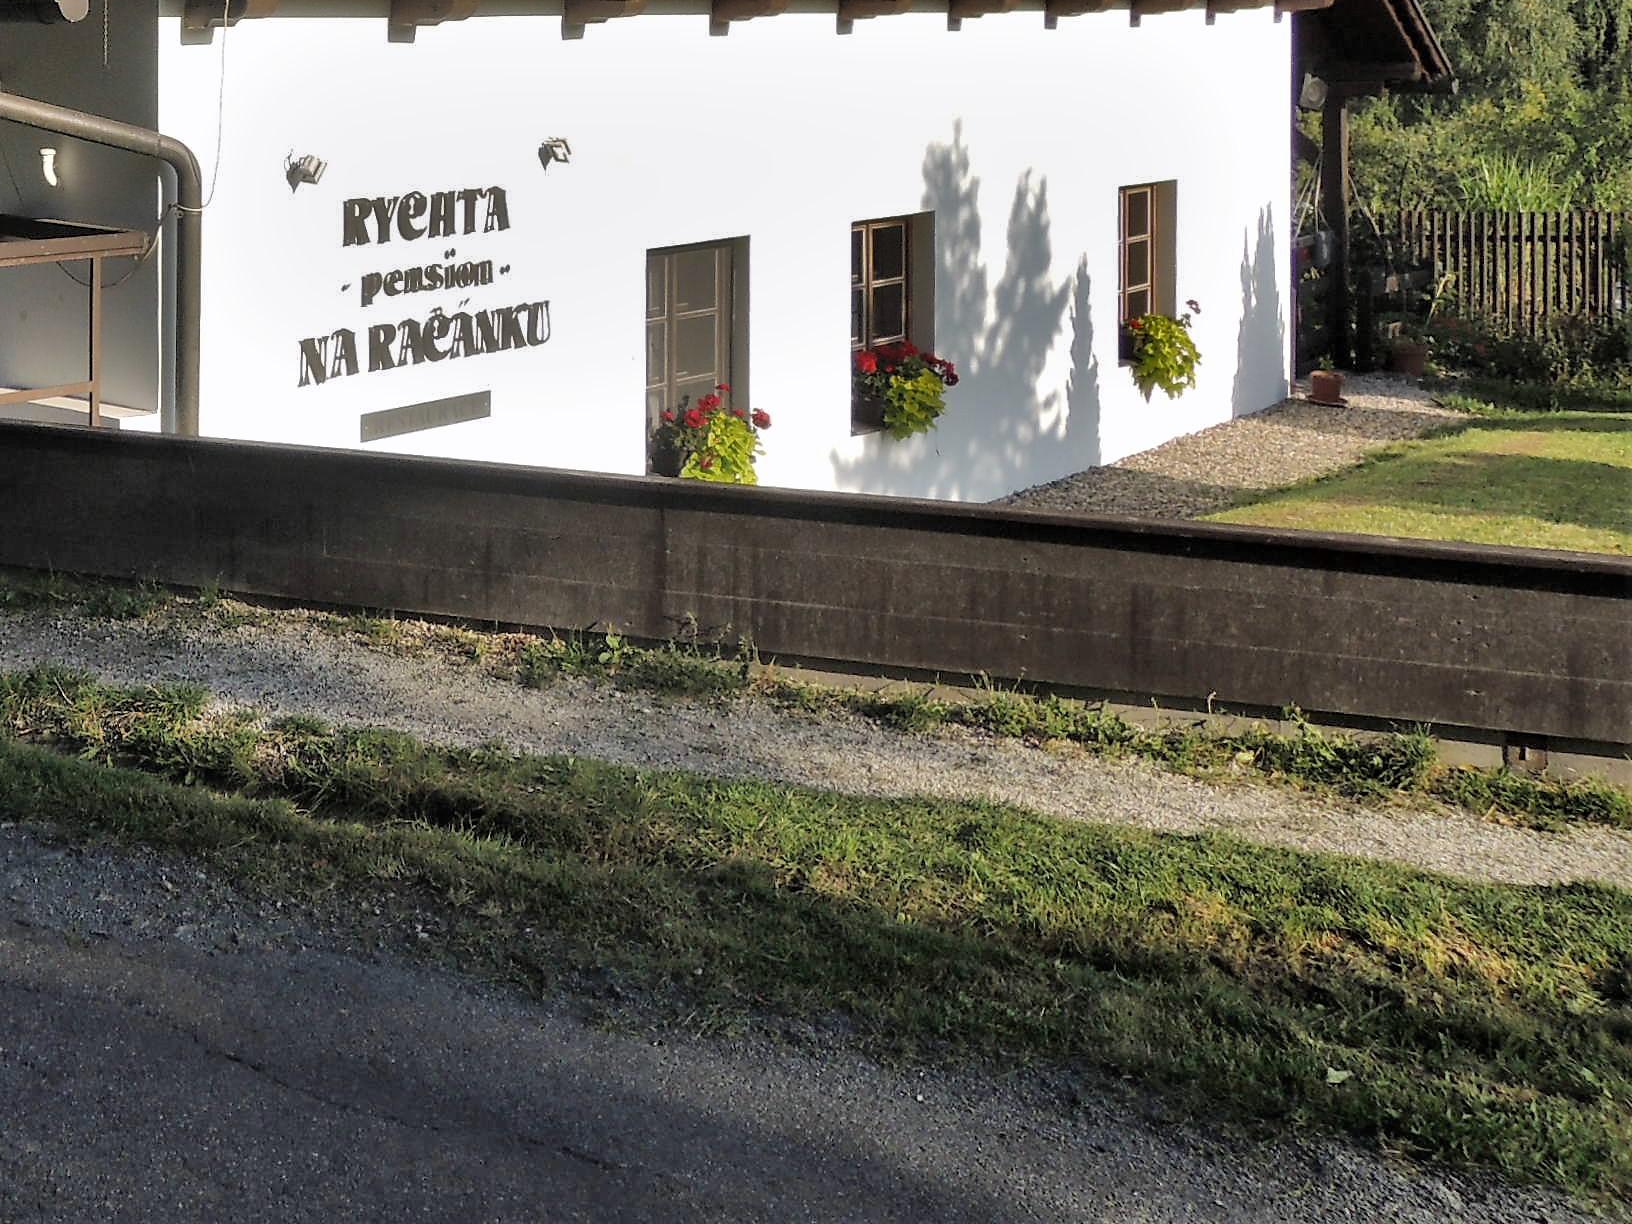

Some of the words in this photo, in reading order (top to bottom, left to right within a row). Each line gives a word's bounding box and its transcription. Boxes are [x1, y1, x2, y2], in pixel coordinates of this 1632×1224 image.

[342, 185, 511, 247] RYCHTA
[360, 248, 494, 307] pension
[297, 327, 360, 388] NA
